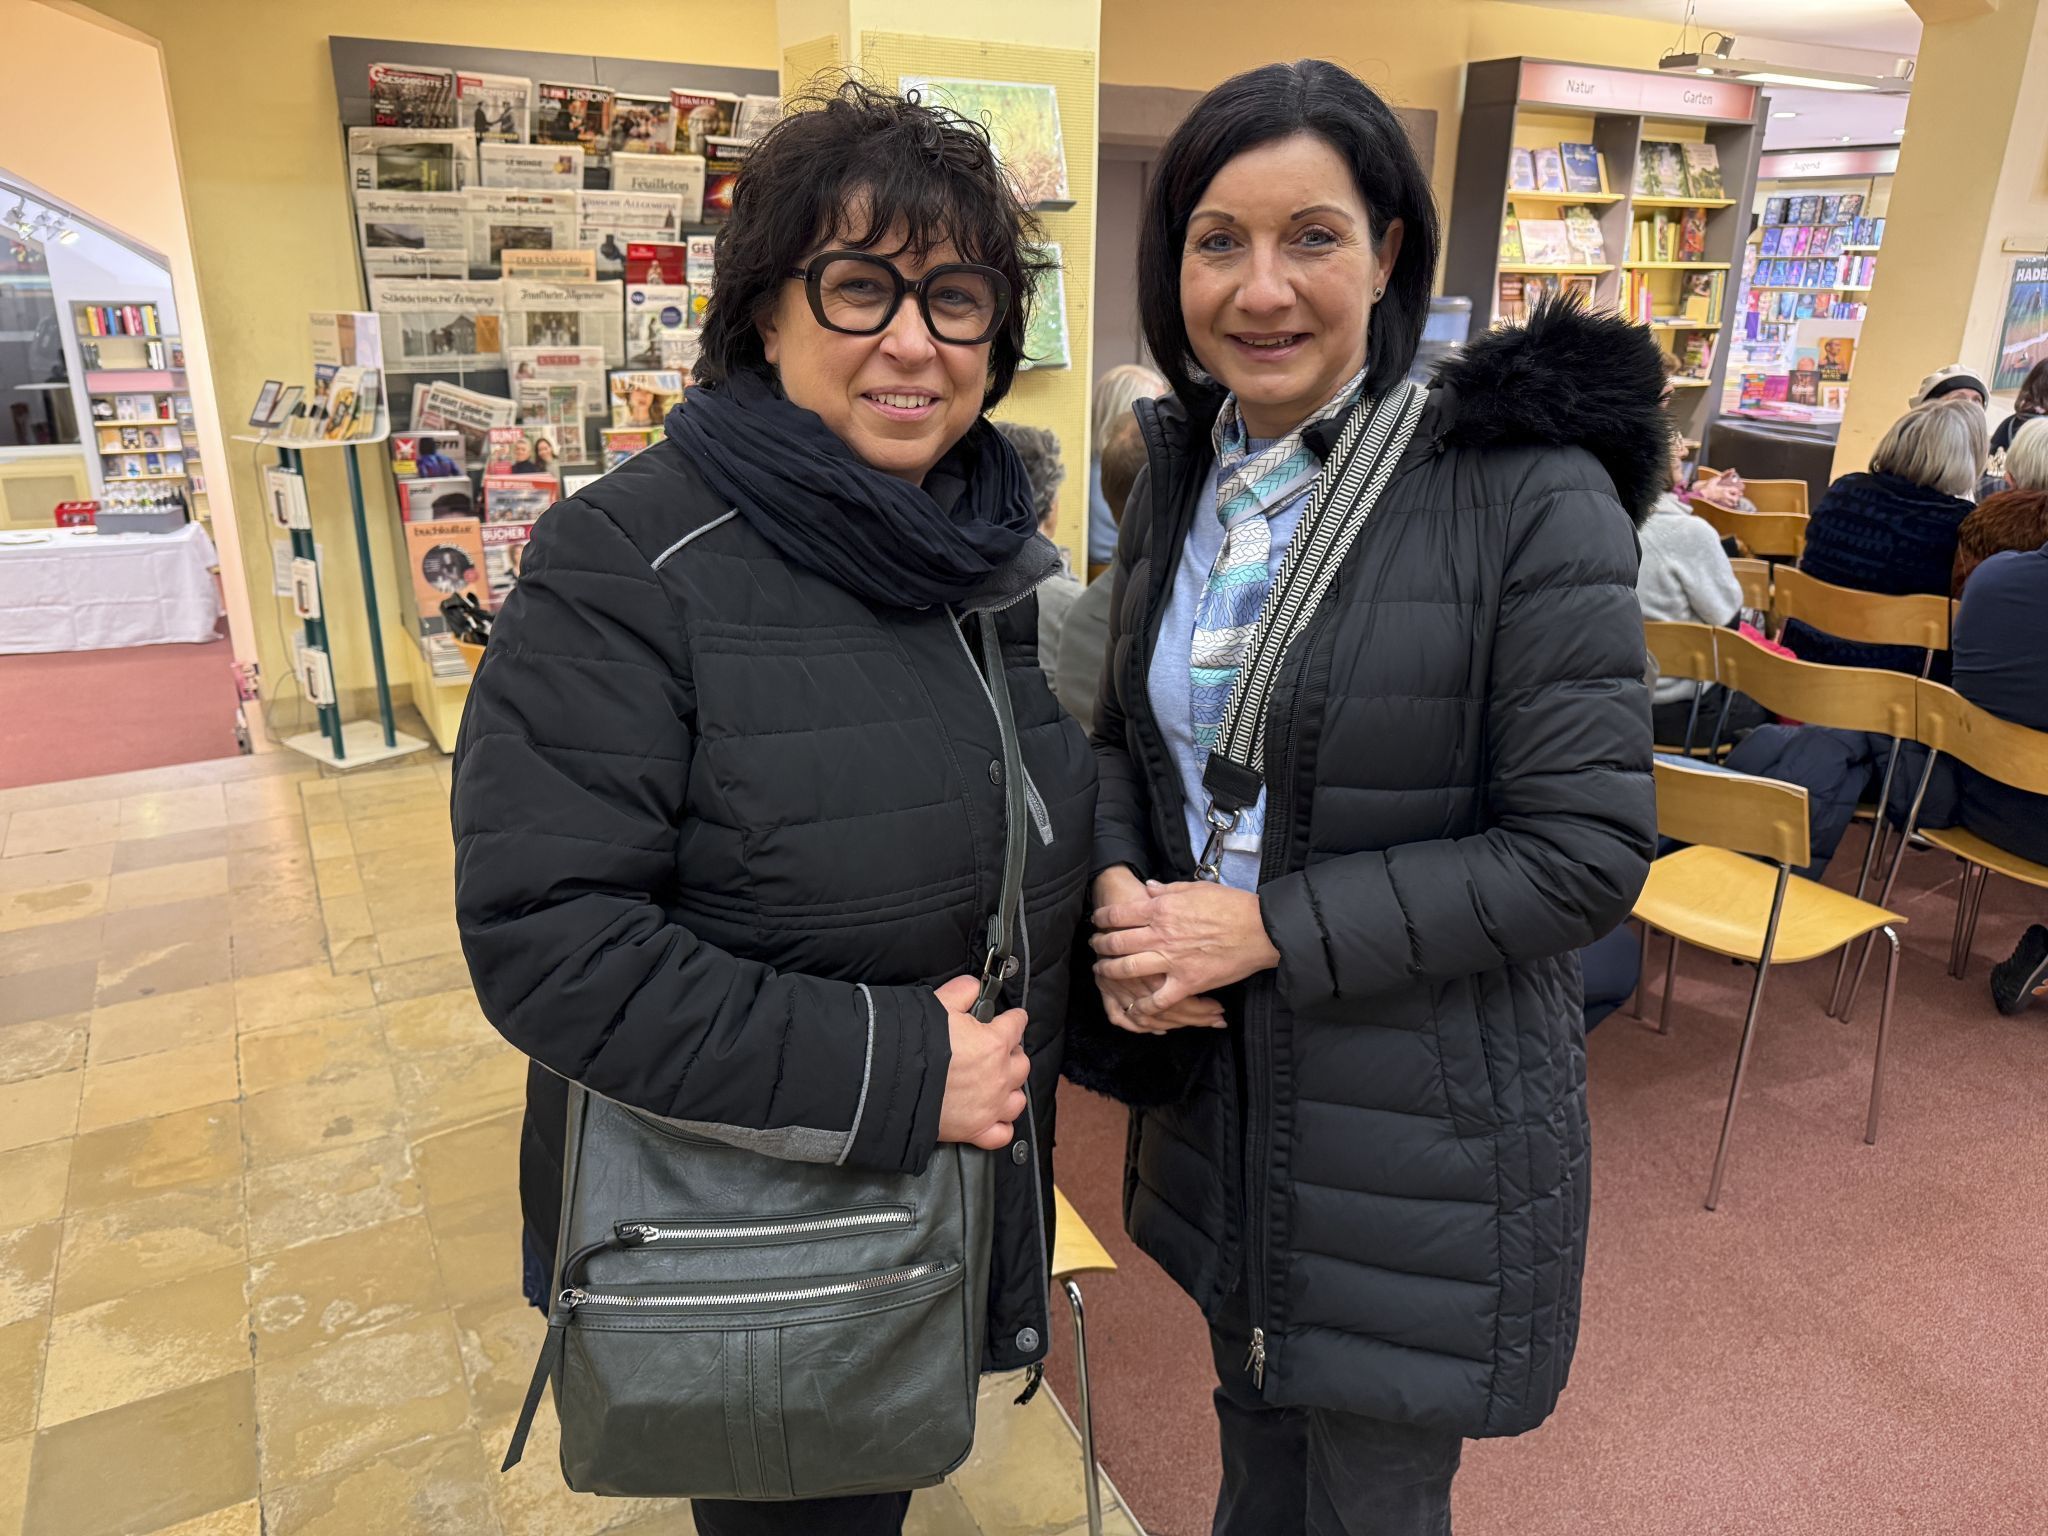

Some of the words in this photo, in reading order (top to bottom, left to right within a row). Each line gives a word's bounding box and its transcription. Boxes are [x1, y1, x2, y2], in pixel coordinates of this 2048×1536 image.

[1566, 79, 1596, 95] Natur
[1682, 90, 1713, 105] Garten
[631, 175, 689, 191] Feuilleton
[2015, 267, 2048, 282] HADE
[436, 438, 459, 449] ern
